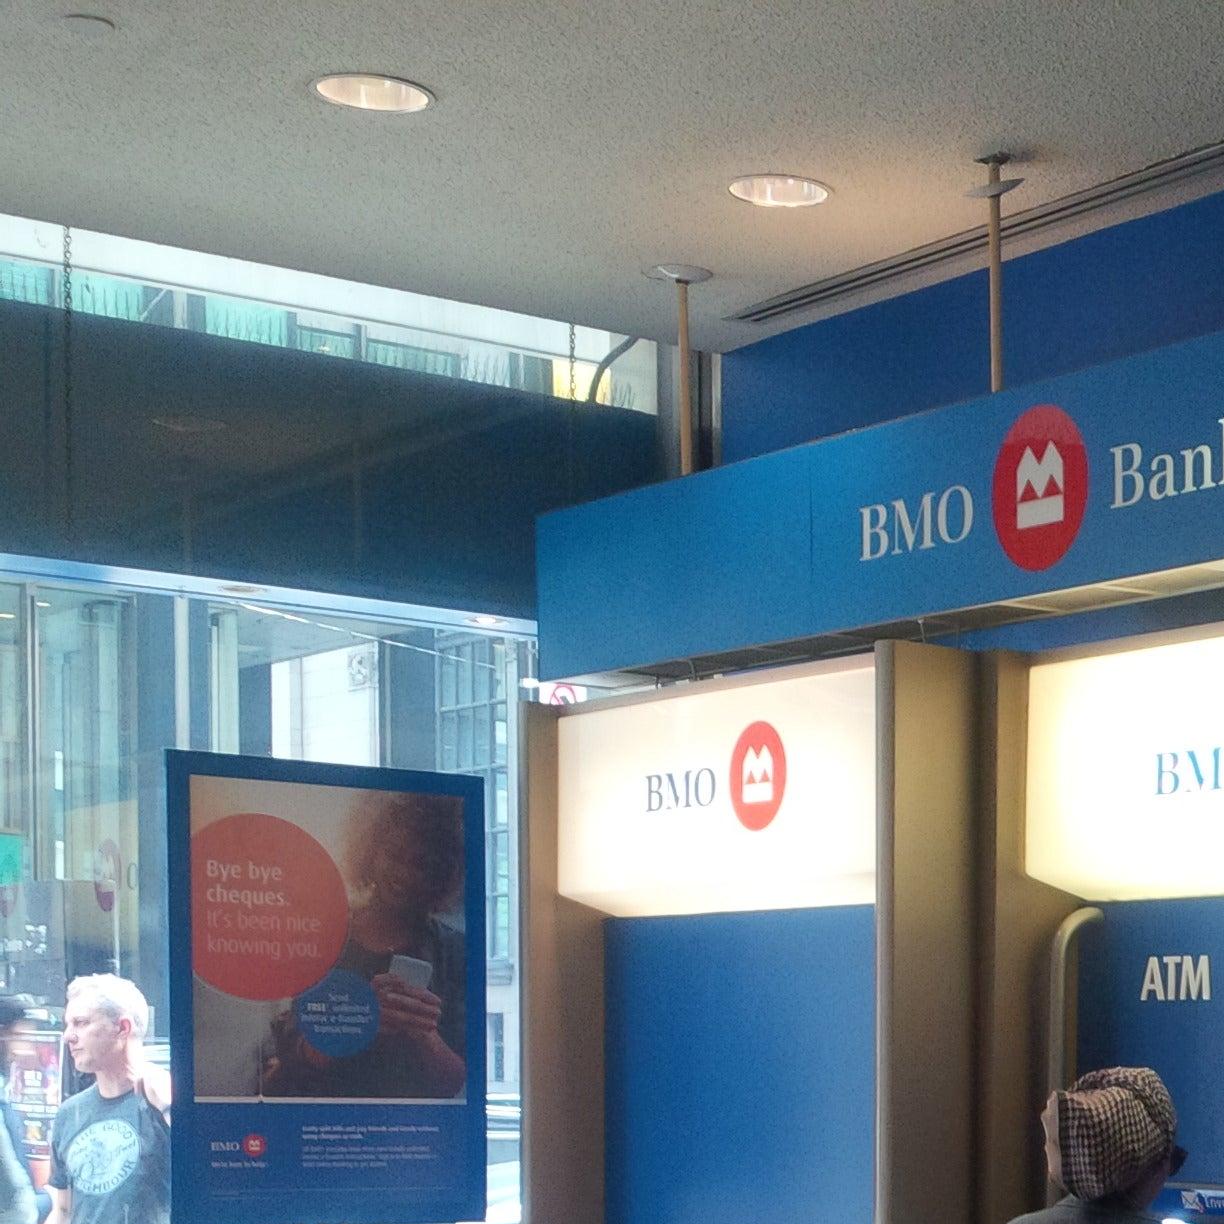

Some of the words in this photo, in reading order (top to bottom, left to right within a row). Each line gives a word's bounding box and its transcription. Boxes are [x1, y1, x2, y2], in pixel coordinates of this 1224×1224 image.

[858, 486, 974, 562] BMO
[646, 767, 716, 813] BMO
[206, 859, 242, 882] Bye
[248, 860, 283, 885] bye
[206, 884, 291, 909] cheques.
[207, 909, 233, 929] It's
[238, 911, 281, 930] been
[286, 914, 321, 933] nice
[206, 933, 281, 960] knowing
[287, 941, 322, 960] you.
[1140, 954, 1212, 1001] ATM
